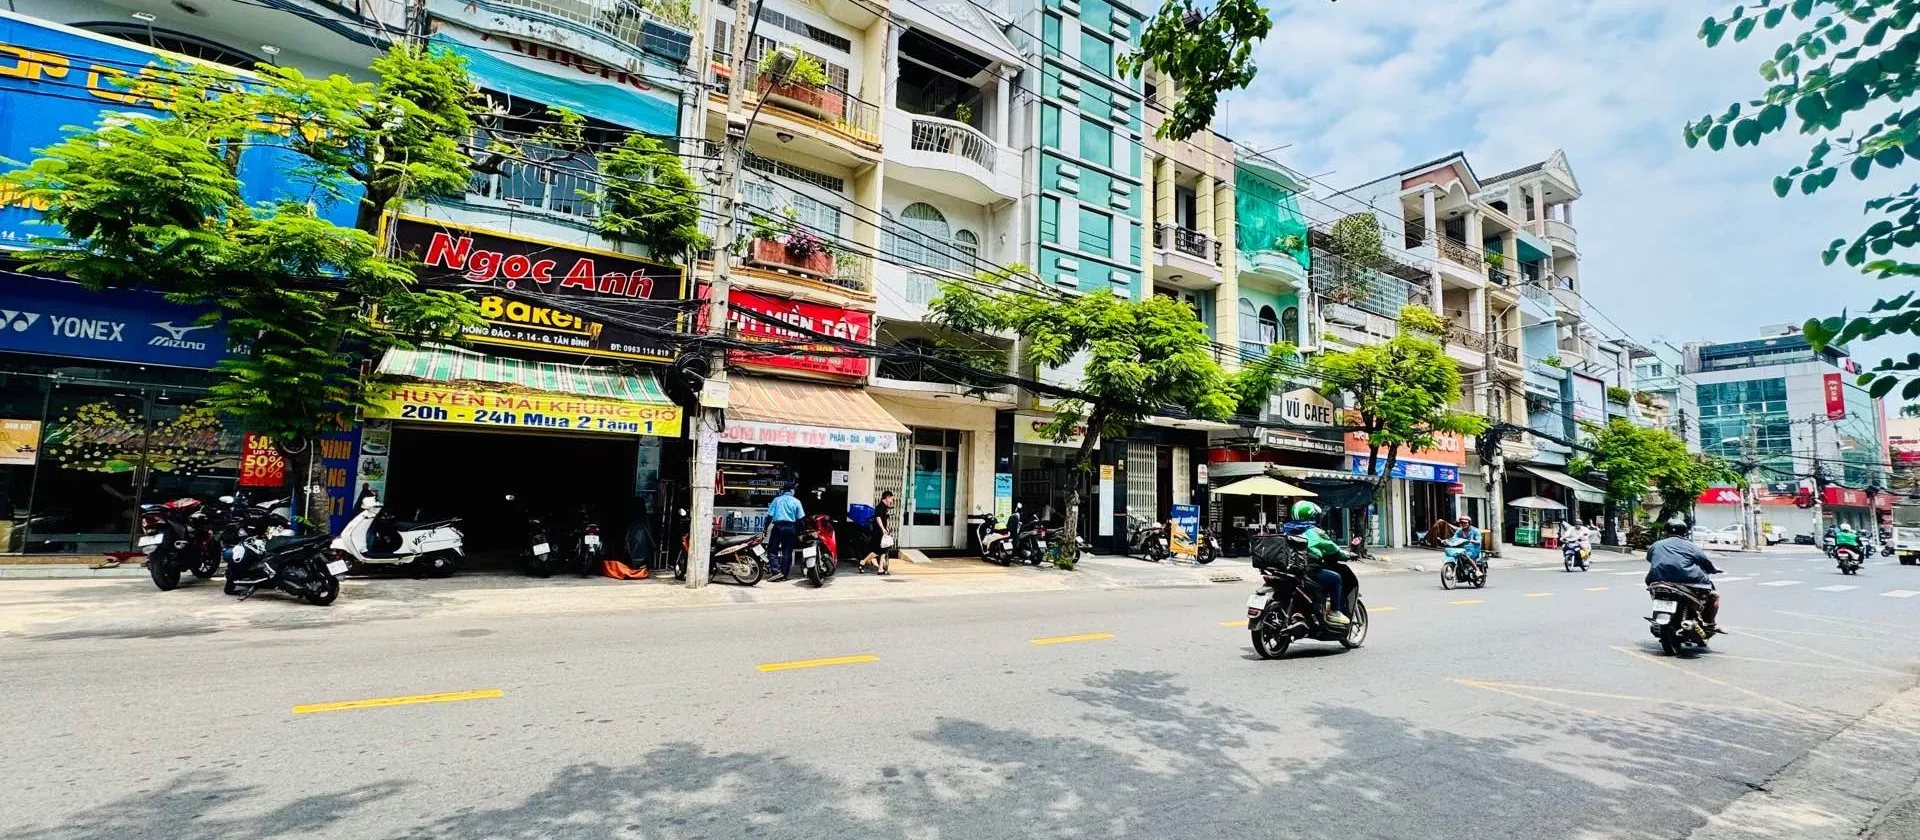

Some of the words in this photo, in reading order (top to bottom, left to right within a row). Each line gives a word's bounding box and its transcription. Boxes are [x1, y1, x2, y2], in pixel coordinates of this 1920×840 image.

[424, 232, 557, 290] Ngọc
[560, 257, 654, 300] Anh
[50, 315, 126, 342] YONEX
[764, 305, 815, 339] MIỀN
[821, 317, 861, 342] TÂY
[491, 327, 511, 339] ĐÀO
[527, 332, 537, 341] 14
[571, 336, 590, 348] BÌNH
[642, 347, 655, 356] 114
[389, 387, 486, 408] HUYẾN
[402, 404, 448, 420] 20h
[474, 409, 517, 425] 24h
[523, 412, 570, 428] Mua
[577, 415, 592, 429] 2
[644, 420, 654, 434] 1
[1304, 402, 1331, 424] CAFE
[244, 454, 285, 468] 50%
[243, 465, 283, 479] 50%
